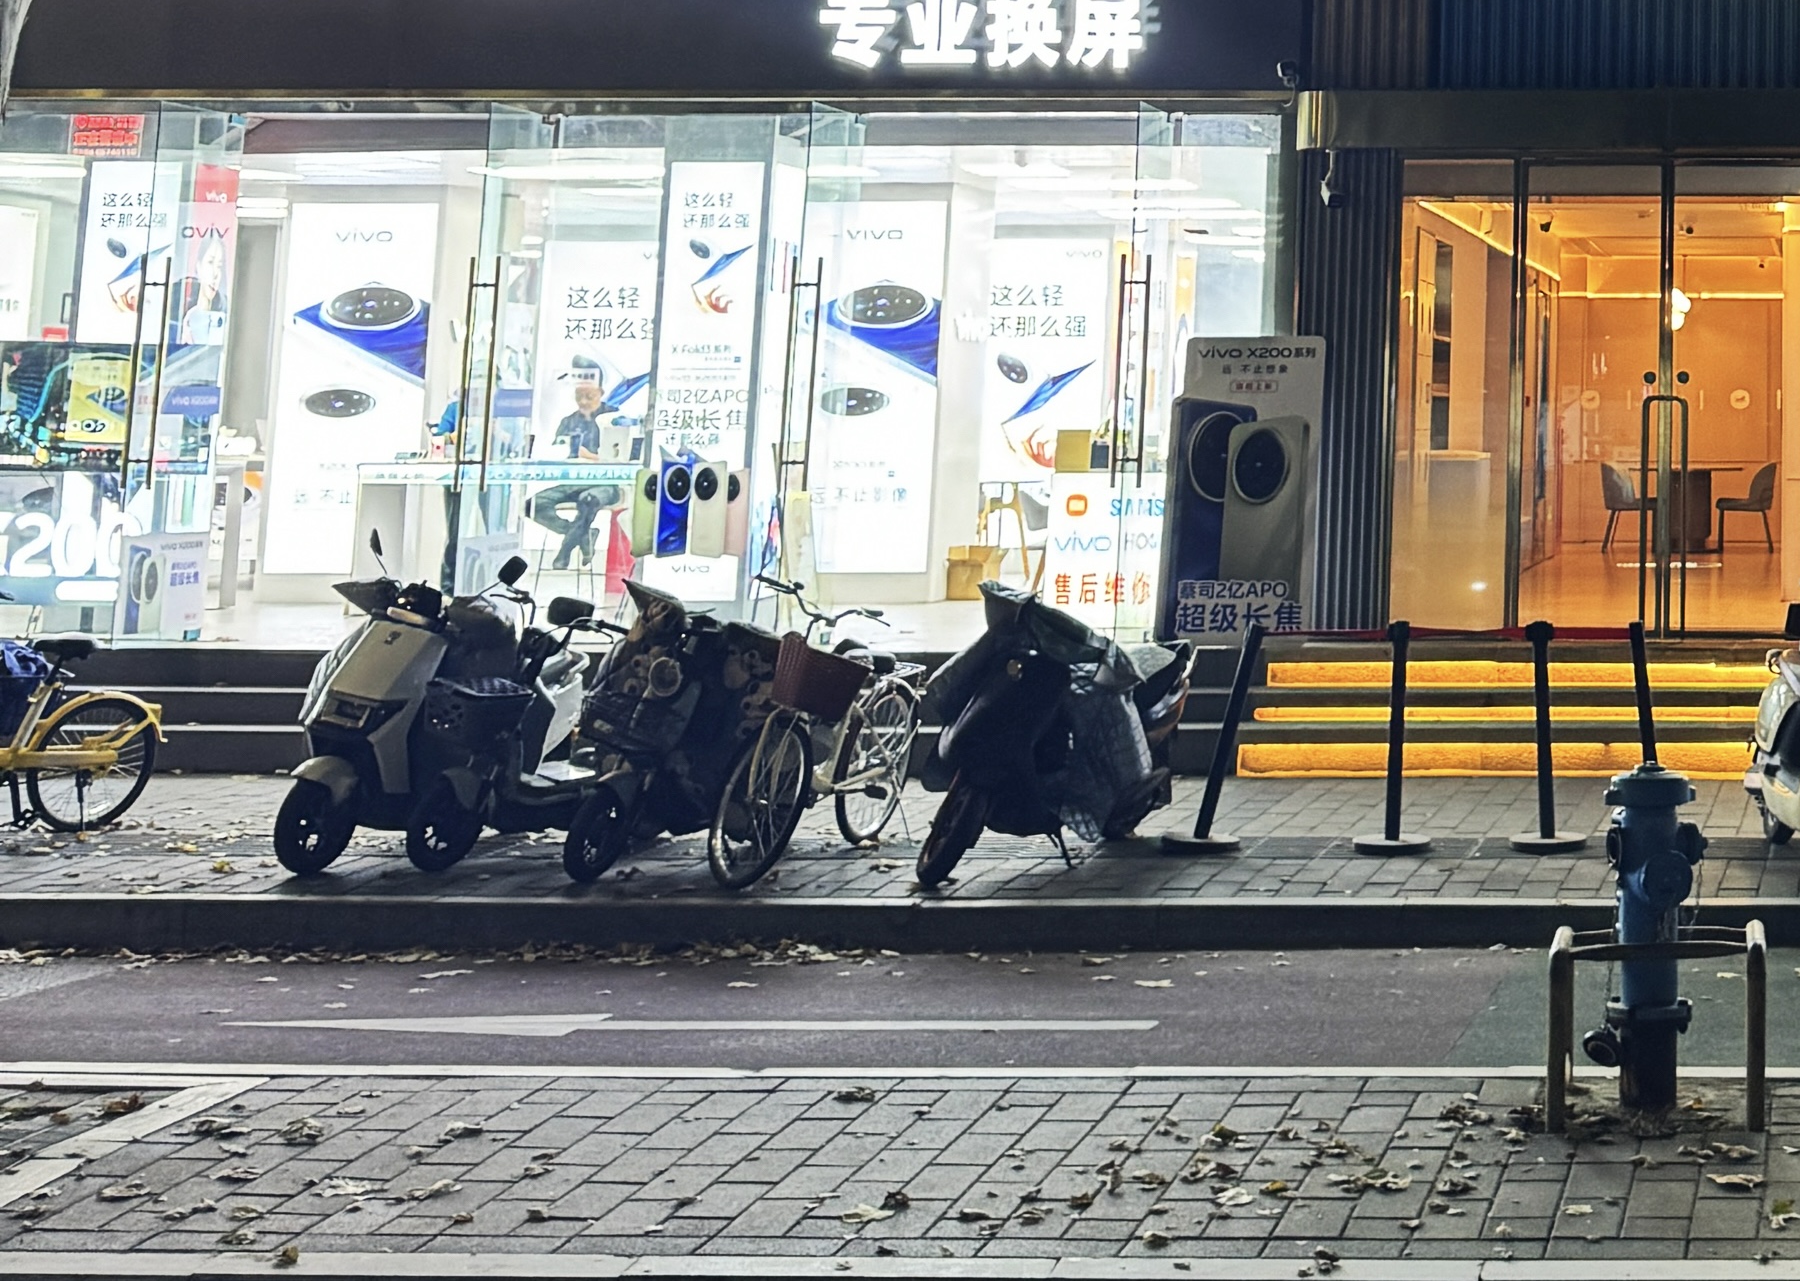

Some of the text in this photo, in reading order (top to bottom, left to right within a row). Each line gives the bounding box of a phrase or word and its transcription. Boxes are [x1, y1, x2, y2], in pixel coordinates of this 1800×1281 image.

[102, 192, 153, 208] 这么轻
[684, 192, 733, 208] 这么轻
[336, 227, 393, 242] vivo
[847, 228, 904, 240] vivo
[566, 286, 640, 308] 这么轻
[990, 285, 1064, 307] 这么轻
[989, 316, 1086, 337] 还那么强
[1198, 345, 1242, 359] vivo
[655, 388, 750, 404] 司2亿APO
[1054, 530, 1112, 551] vivo
[1179, 580, 1288, 600] 蔡司2亿APO
[1176, 602, 1304, 633] 超级长焦
